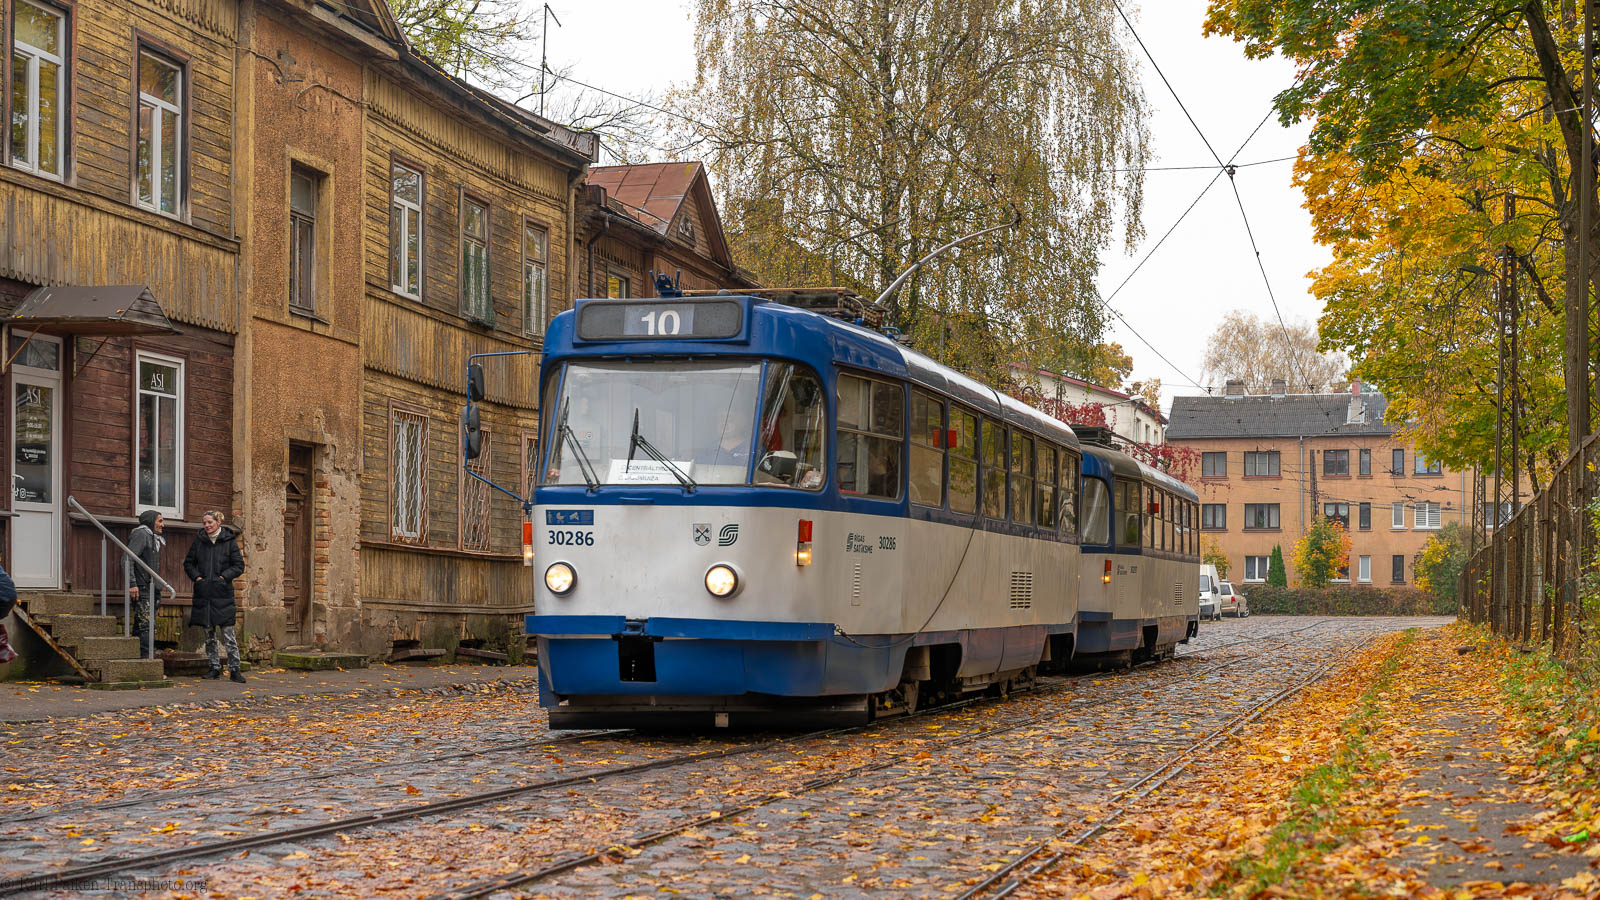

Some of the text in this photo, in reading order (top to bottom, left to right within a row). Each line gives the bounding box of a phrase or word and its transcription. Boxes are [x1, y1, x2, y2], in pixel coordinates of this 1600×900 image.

[641, 310, 681, 335] 10
[151, 372, 164, 388] ASI
[26, 386, 41, 403] ASI
[548, 530, 595, 546] 30286
[879, 535, 897, 550] 30286
